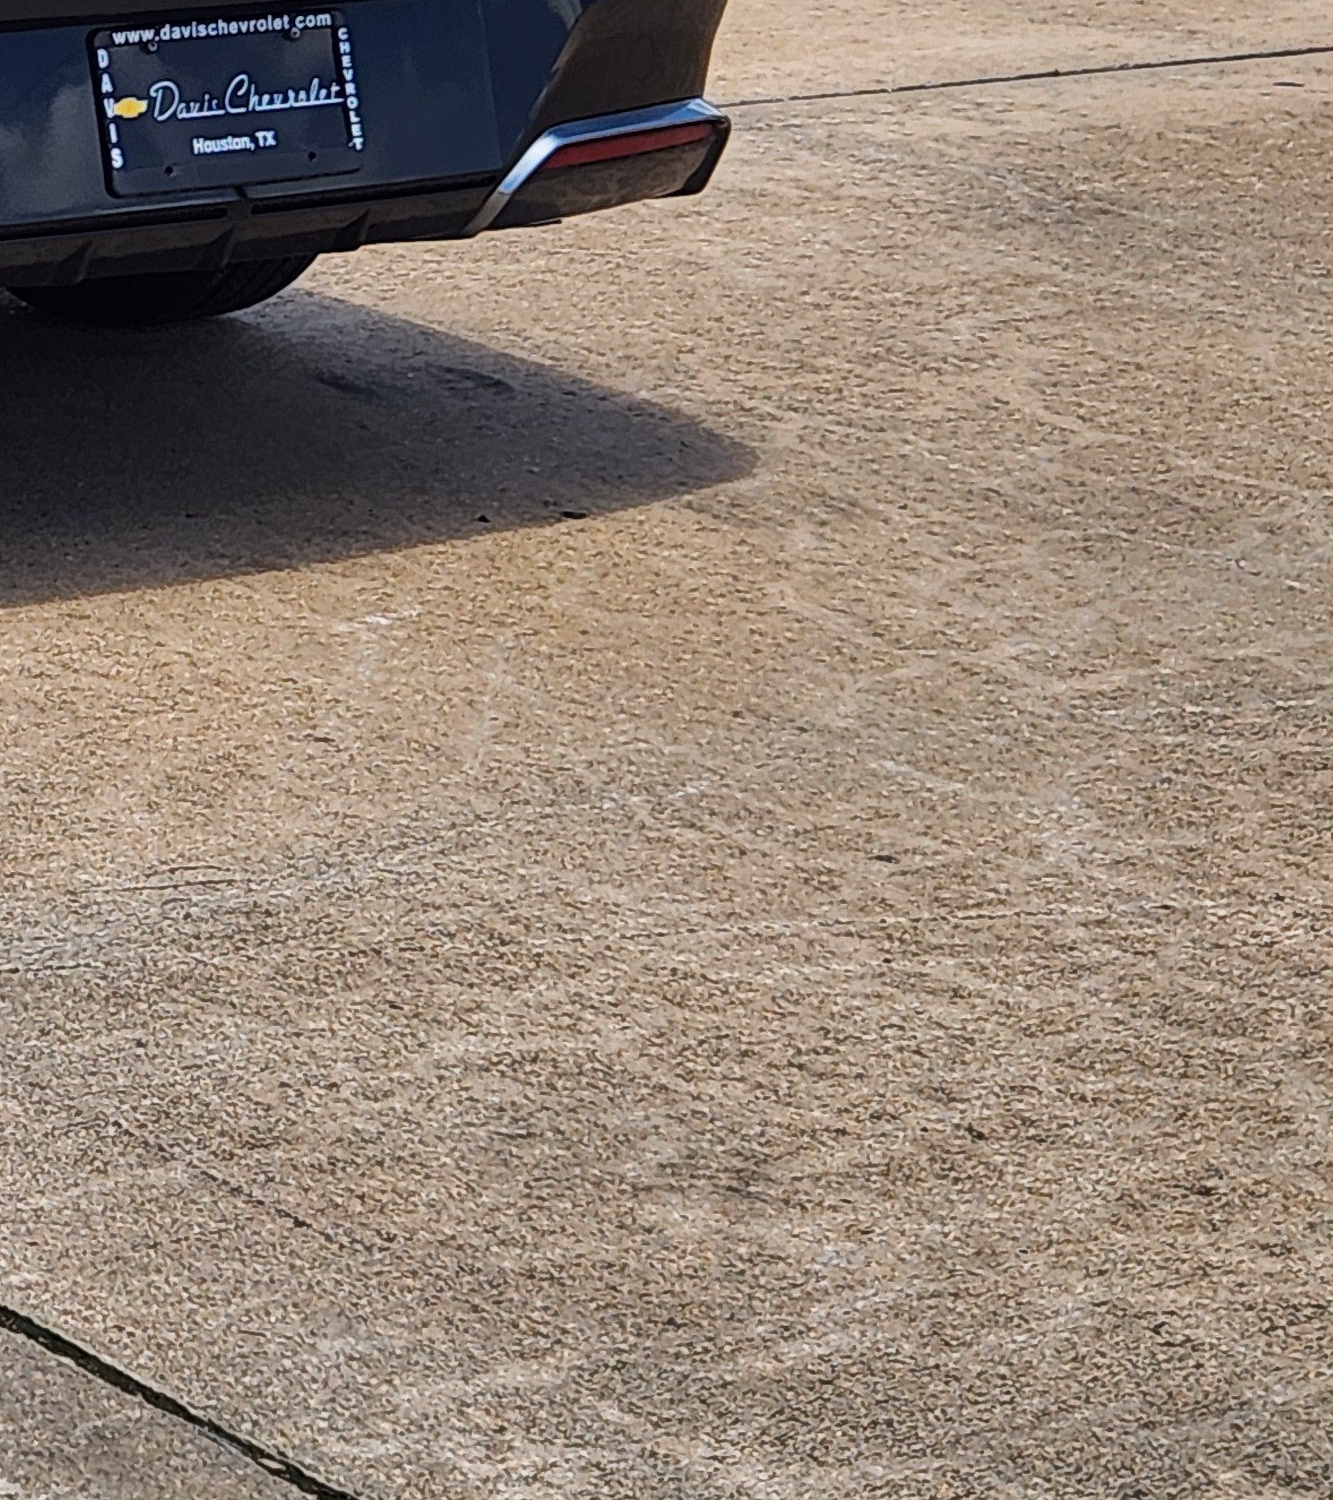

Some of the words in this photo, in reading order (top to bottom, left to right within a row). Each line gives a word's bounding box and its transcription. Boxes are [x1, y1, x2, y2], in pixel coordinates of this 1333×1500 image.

[112, 13, 332, 46] www.davischevroletcom
[96, 48, 124, 169] DAVIS
[149, 80, 222, 122] Davis
[225, 74, 344, 114] Chevrolet
[337, 26, 364, 151] CHEVROLET
[192, 135, 255, 155] Houston,
[254, 130, 277, 148] TX
